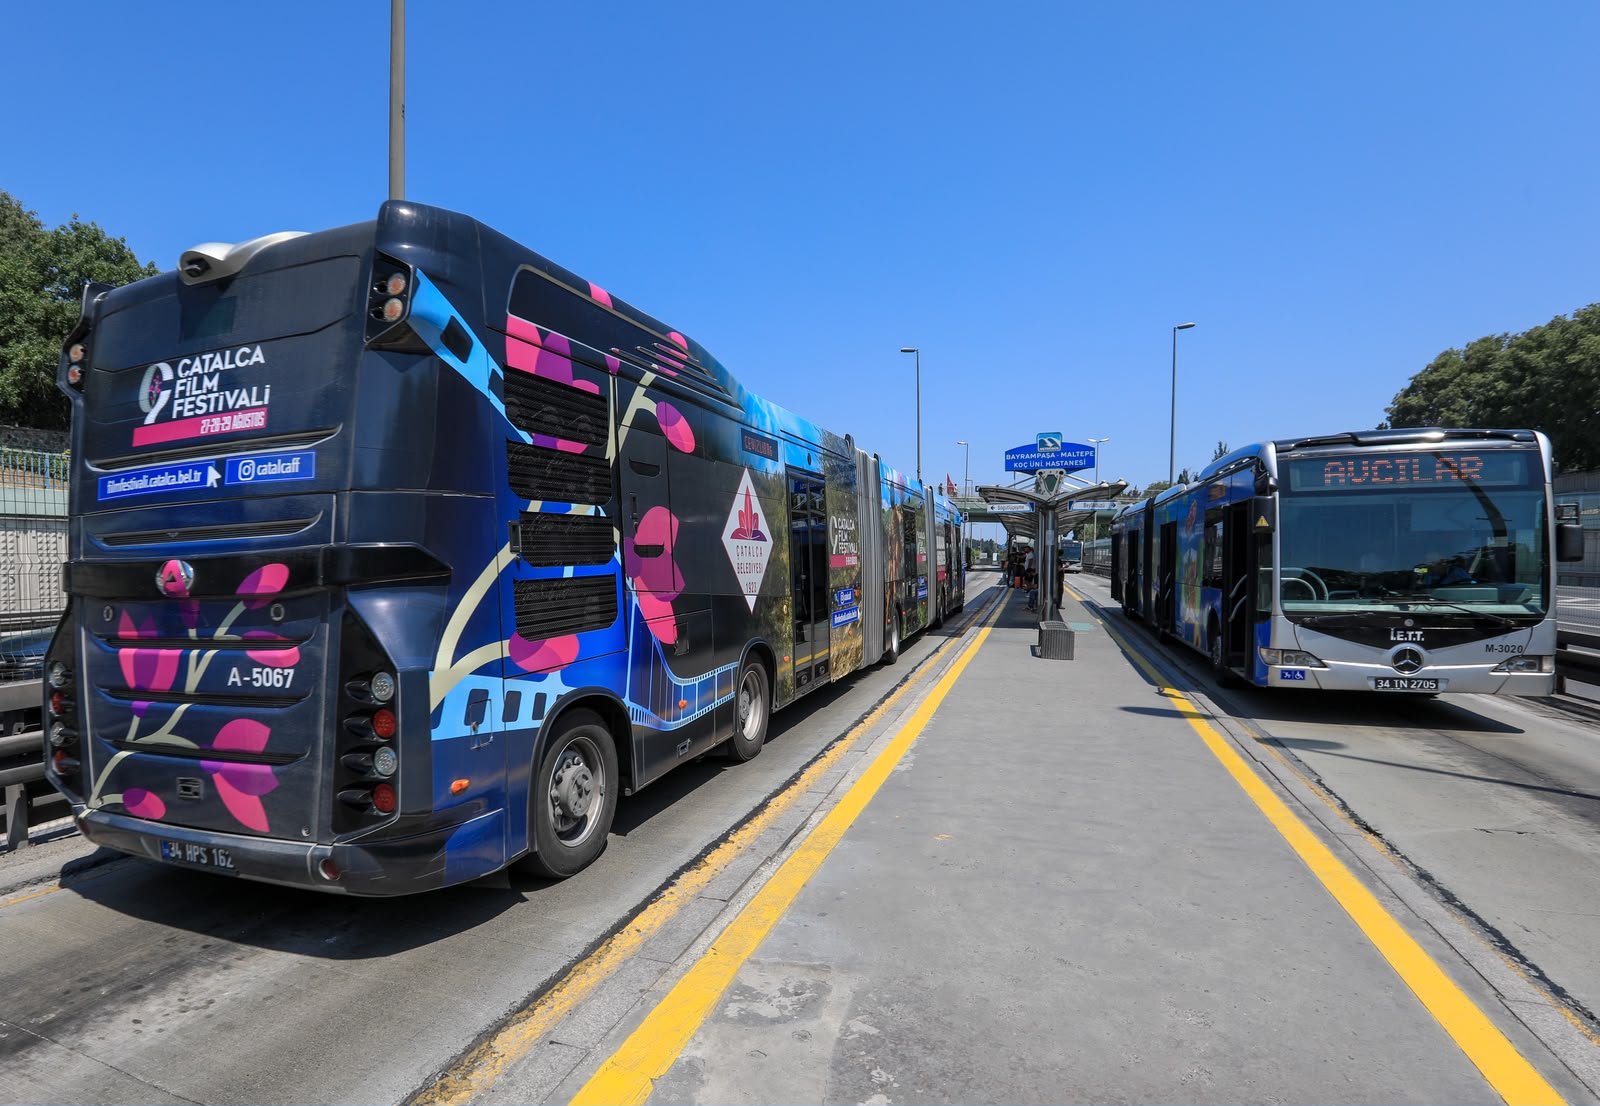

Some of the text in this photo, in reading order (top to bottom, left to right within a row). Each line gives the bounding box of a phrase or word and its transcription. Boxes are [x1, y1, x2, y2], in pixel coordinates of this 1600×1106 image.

[177, 345, 265, 378] ÇATALCA
[1006, 452, 1055, 460] BAYRAMPAŞA
[256, 457, 300, 476] catalcaff
[735, 544, 763, 560] ÇATALCA
[1485, 644, 1524, 654] M-3020
[227, 667, 295, 689] A-5067
[1377, 679, 1436, 689] 34 TN 2705
[168, 842, 234, 869] 34 HPS 162
